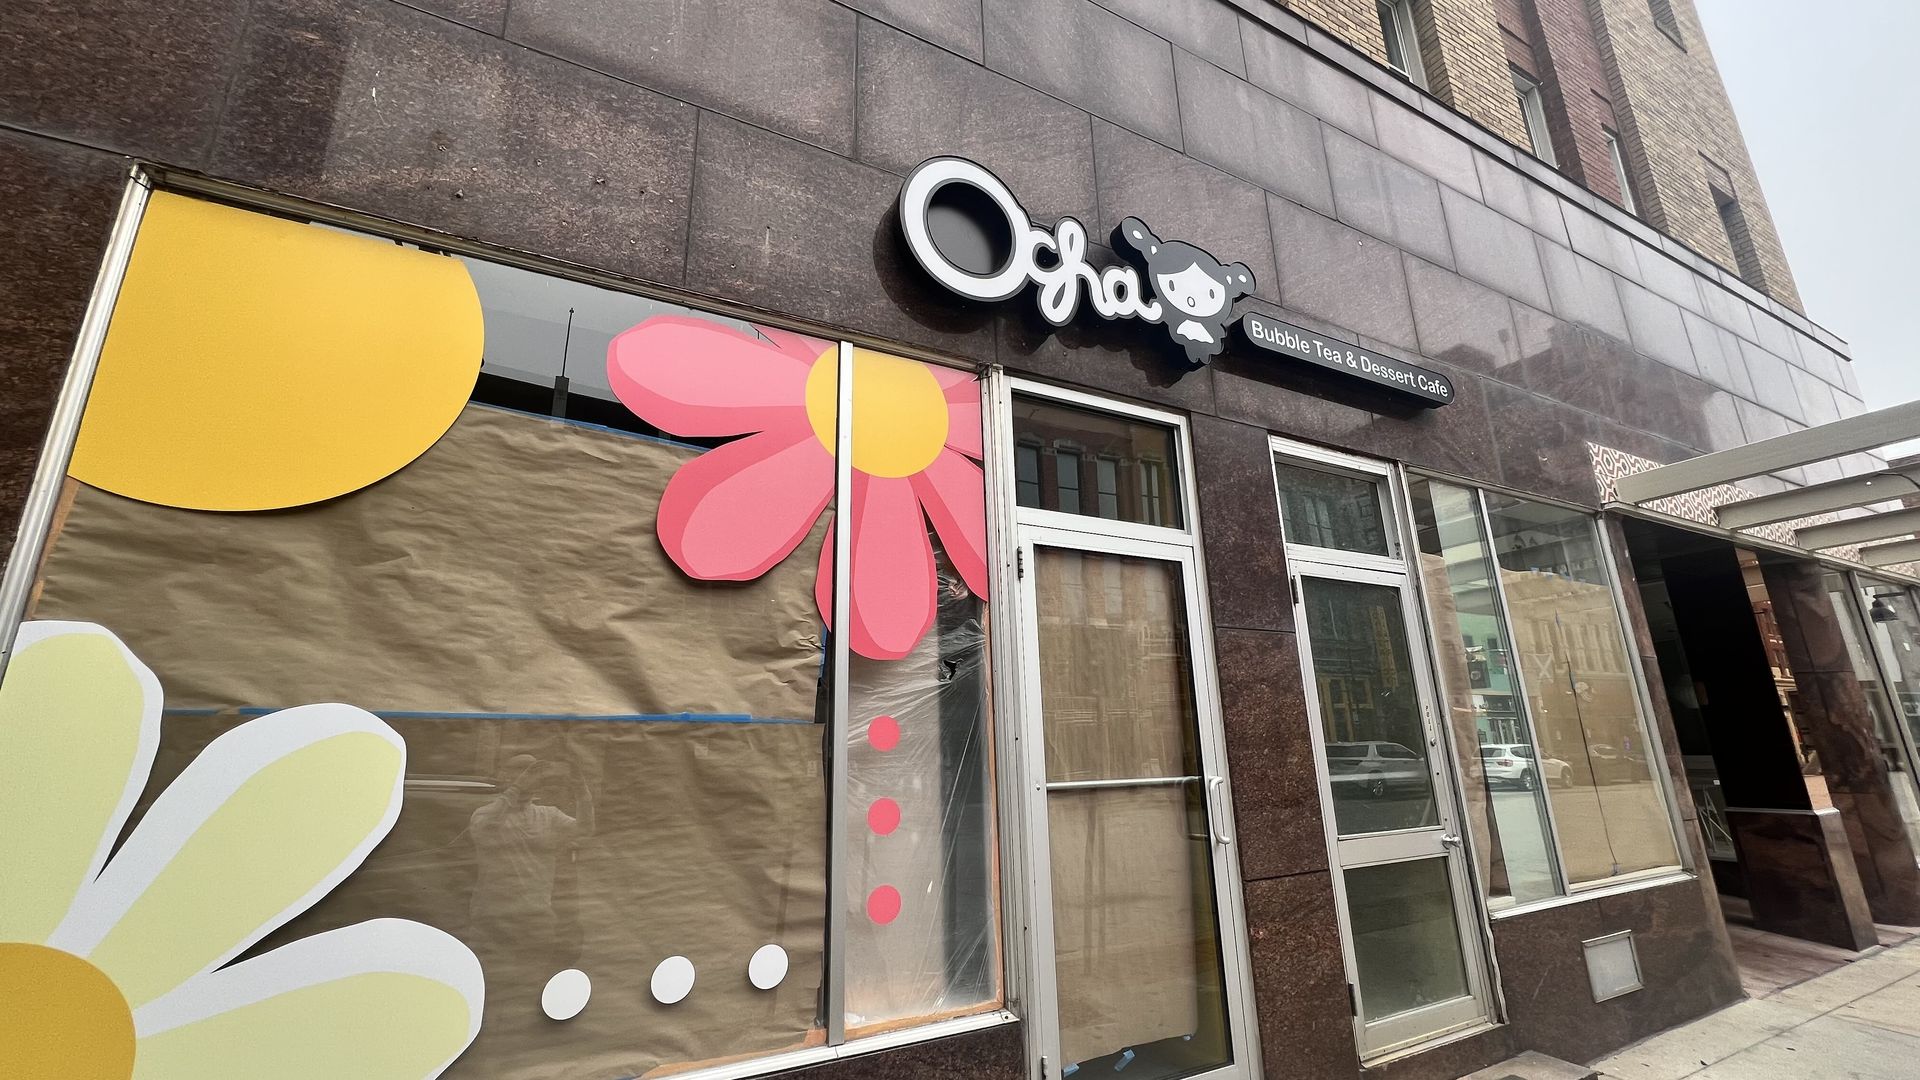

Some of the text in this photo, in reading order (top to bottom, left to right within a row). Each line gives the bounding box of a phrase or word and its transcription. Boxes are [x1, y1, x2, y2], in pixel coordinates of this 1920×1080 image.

[903, 159, 1163, 323] Ocha
[1251, 320, 1448, 397] Bubble Tea & Dessert Cafe
